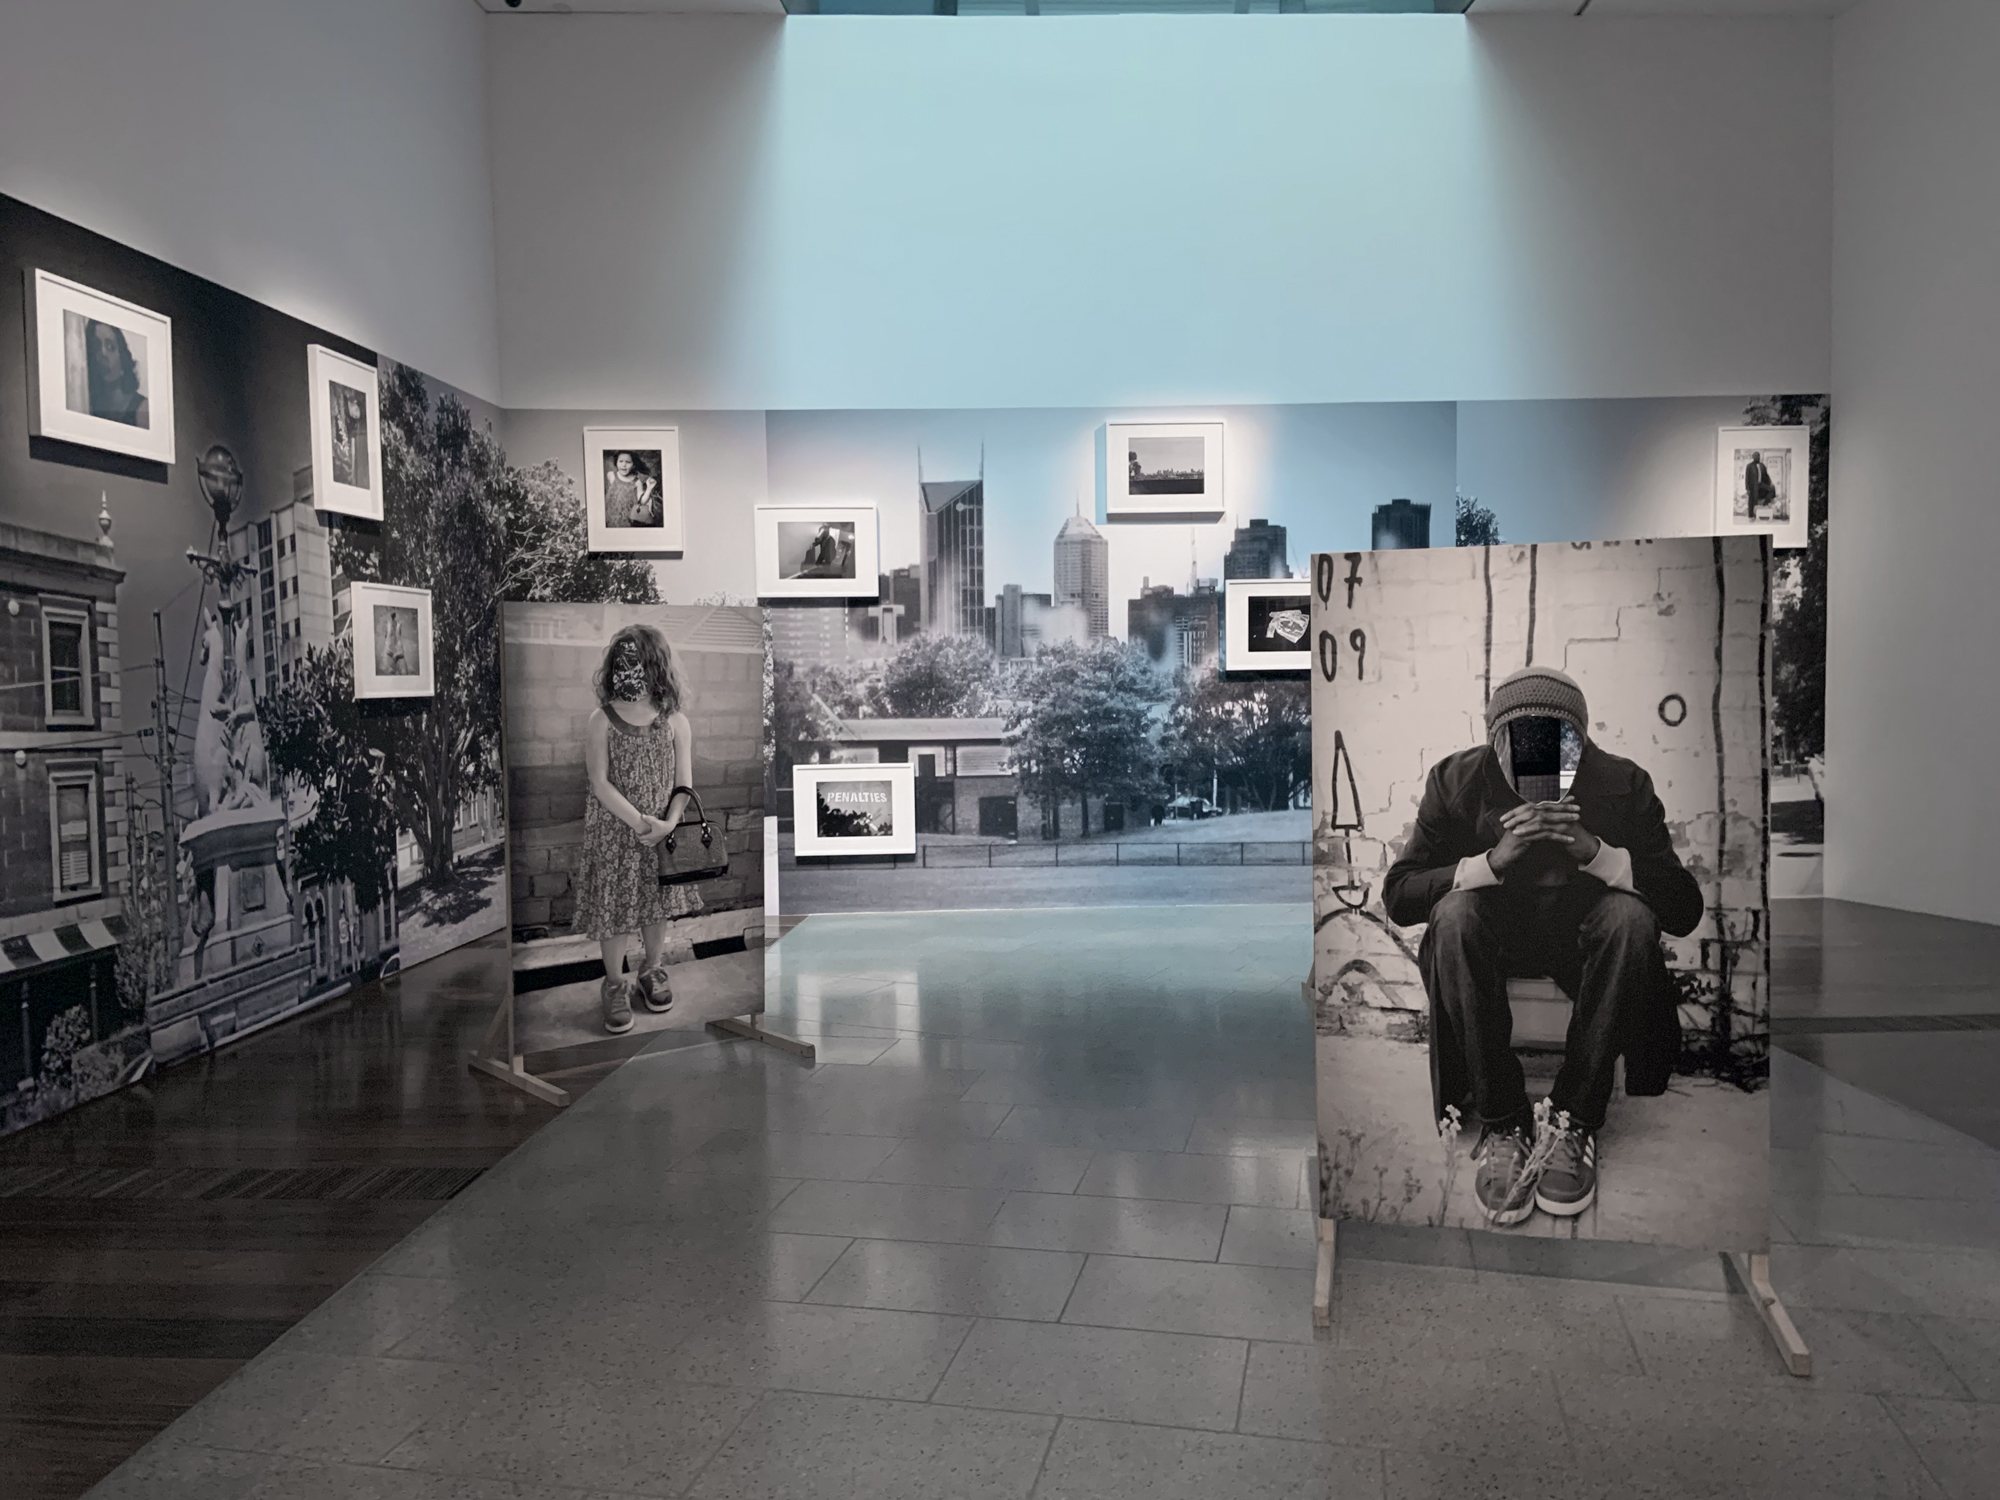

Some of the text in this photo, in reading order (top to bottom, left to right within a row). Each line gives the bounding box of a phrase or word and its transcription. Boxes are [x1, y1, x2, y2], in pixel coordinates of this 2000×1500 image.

[1317, 552, 1363, 611] 07
[1319, 628, 1366, 682] 09
[826, 792, 888, 803] PENALTIES
